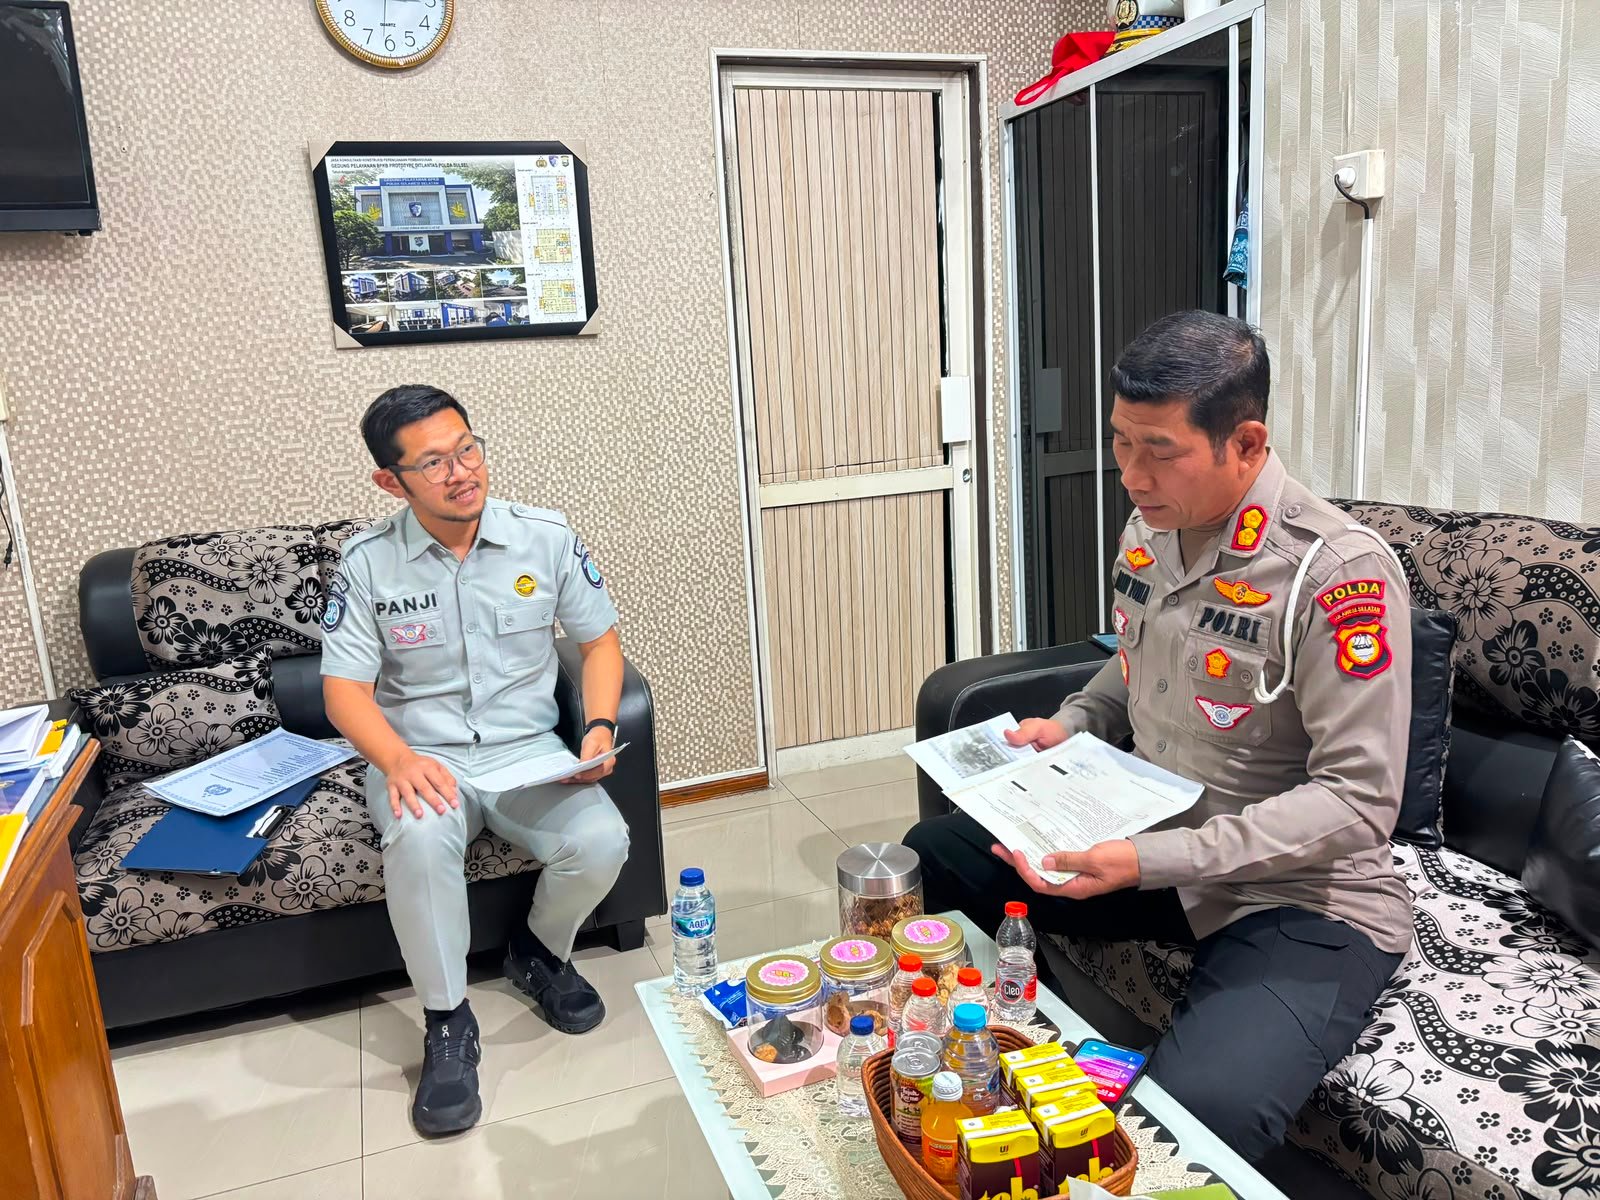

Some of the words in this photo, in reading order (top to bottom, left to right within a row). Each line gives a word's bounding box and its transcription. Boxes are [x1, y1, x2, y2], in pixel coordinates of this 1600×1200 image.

[344, 10, 356, 27] 8
[419, 15, 430, 31] 4
[363, 28, 374, 45] 7
[385, 34, 396, 52] 6
[405, 31, 416, 47] 5
[1323, 582, 1380, 606] POLDA
[375, 593, 437, 616] PANJI
[1198, 607, 1262, 644] POLRI
[689, 918, 710, 928] AQUA
[1004, 984, 1020, 996] Cleo
